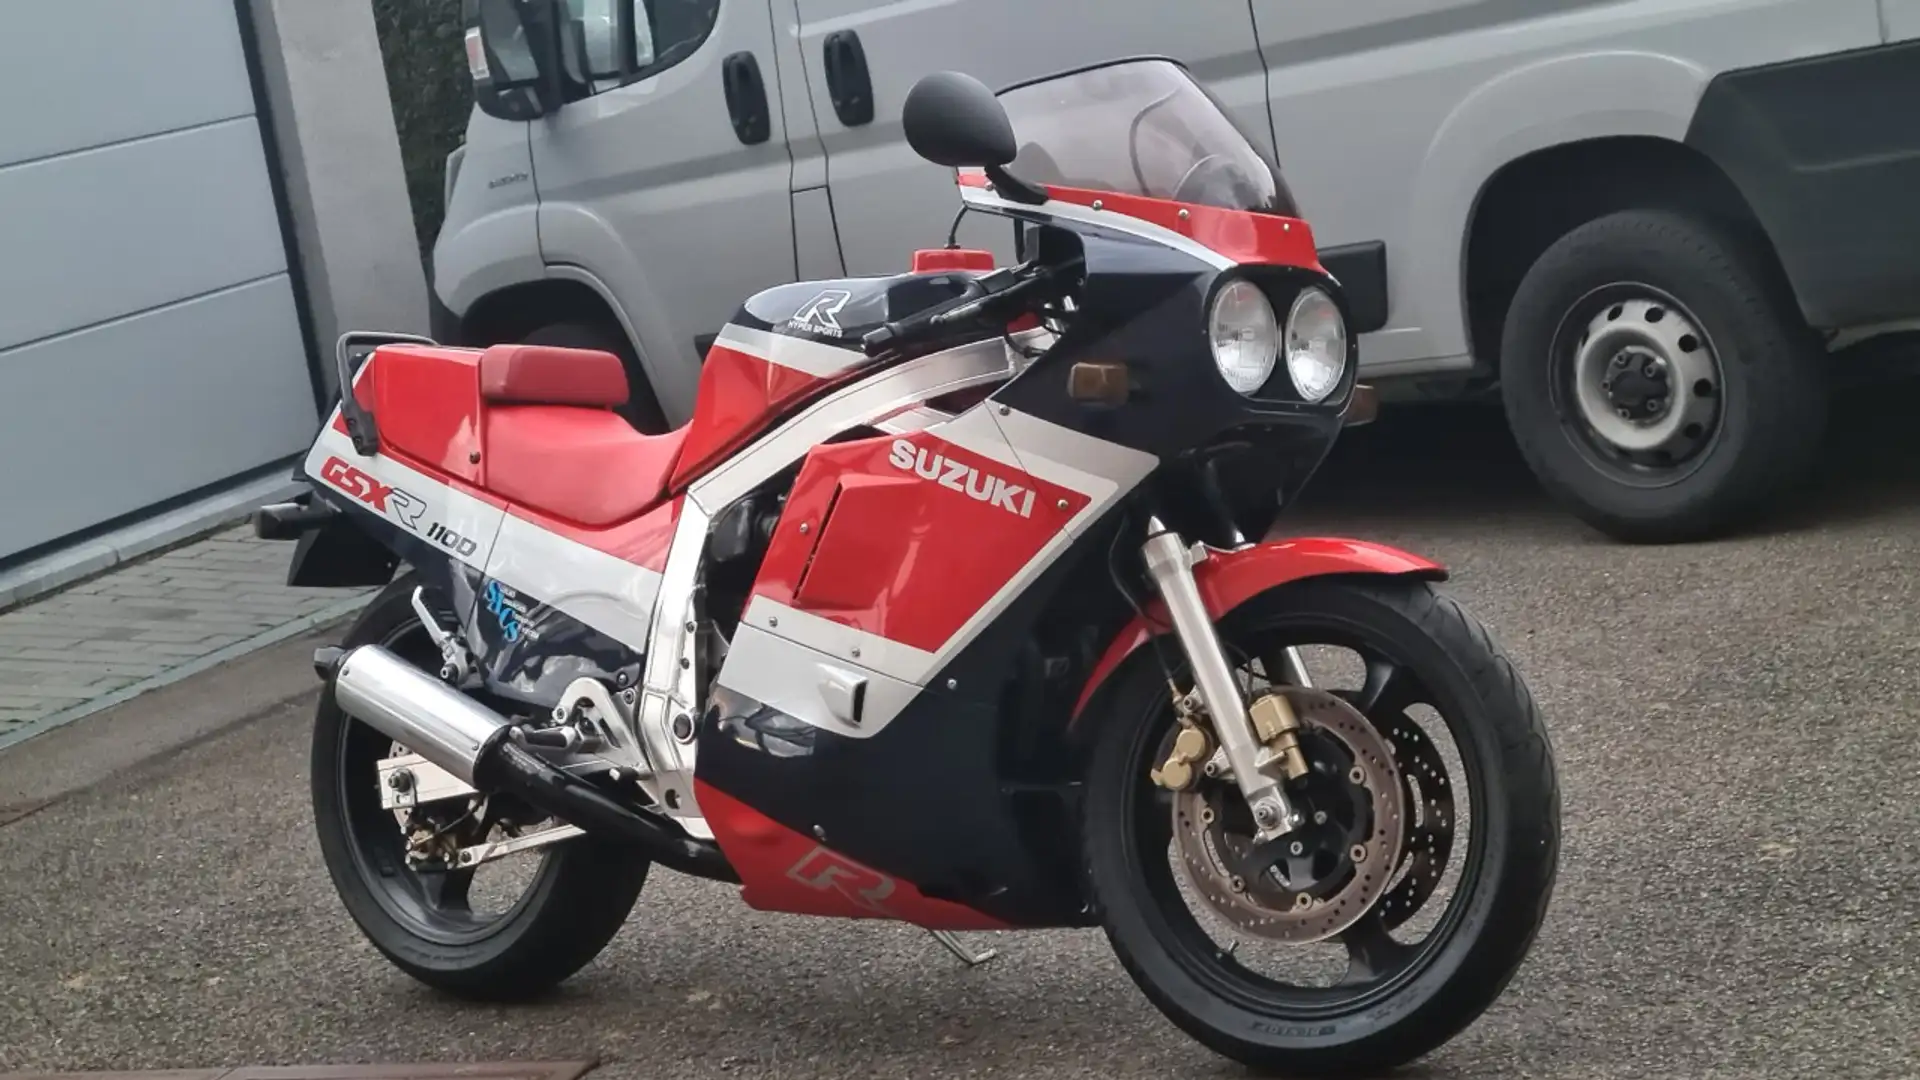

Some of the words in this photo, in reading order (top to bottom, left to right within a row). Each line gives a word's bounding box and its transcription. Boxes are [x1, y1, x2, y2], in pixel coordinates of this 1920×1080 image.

[788, 320, 812, 332] HYPER
[813, 325, 843, 338] SPORTS
[794, 289, 851, 329] R
[889, 439, 1036, 519] SUZUKI
